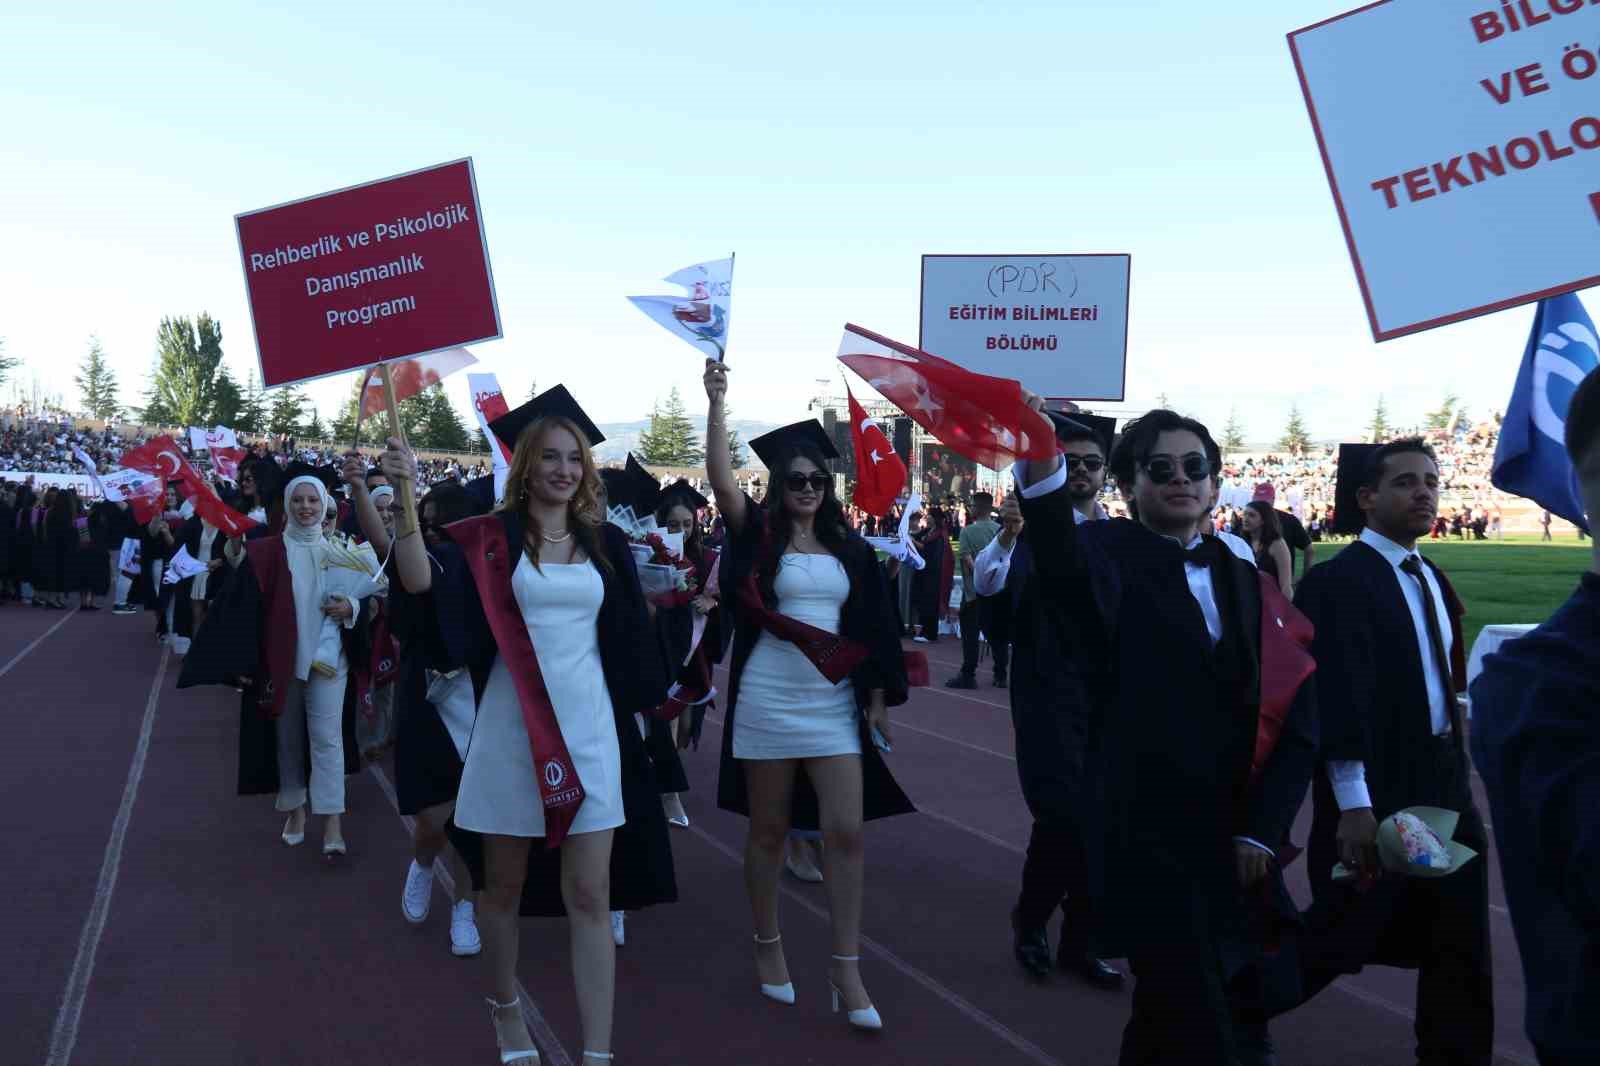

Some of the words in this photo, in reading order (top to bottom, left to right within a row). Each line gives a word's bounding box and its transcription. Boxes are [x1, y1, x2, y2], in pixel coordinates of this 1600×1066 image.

[1470, 0, 1600, 43] BİL
[1479, 62, 1550, 105] VE
[1562, 43, 1600, 80] Ö
[1371, 116, 1600, 209] TEKNOLO
[250, 235, 343, 272] Rehberlik
[346, 230, 370, 249] ve
[375, 203, 469, 242] Psikolojik
[306, 253, 424, 296] Danışmanlık
[326, 295, 416, 329] Programı
[949, 304, 1007, 321] EĞİTİM
[1012, 304, 1098, 321] BİLİMLERİ
[986, 334, 1058, 351] BÖLÜMÜ
